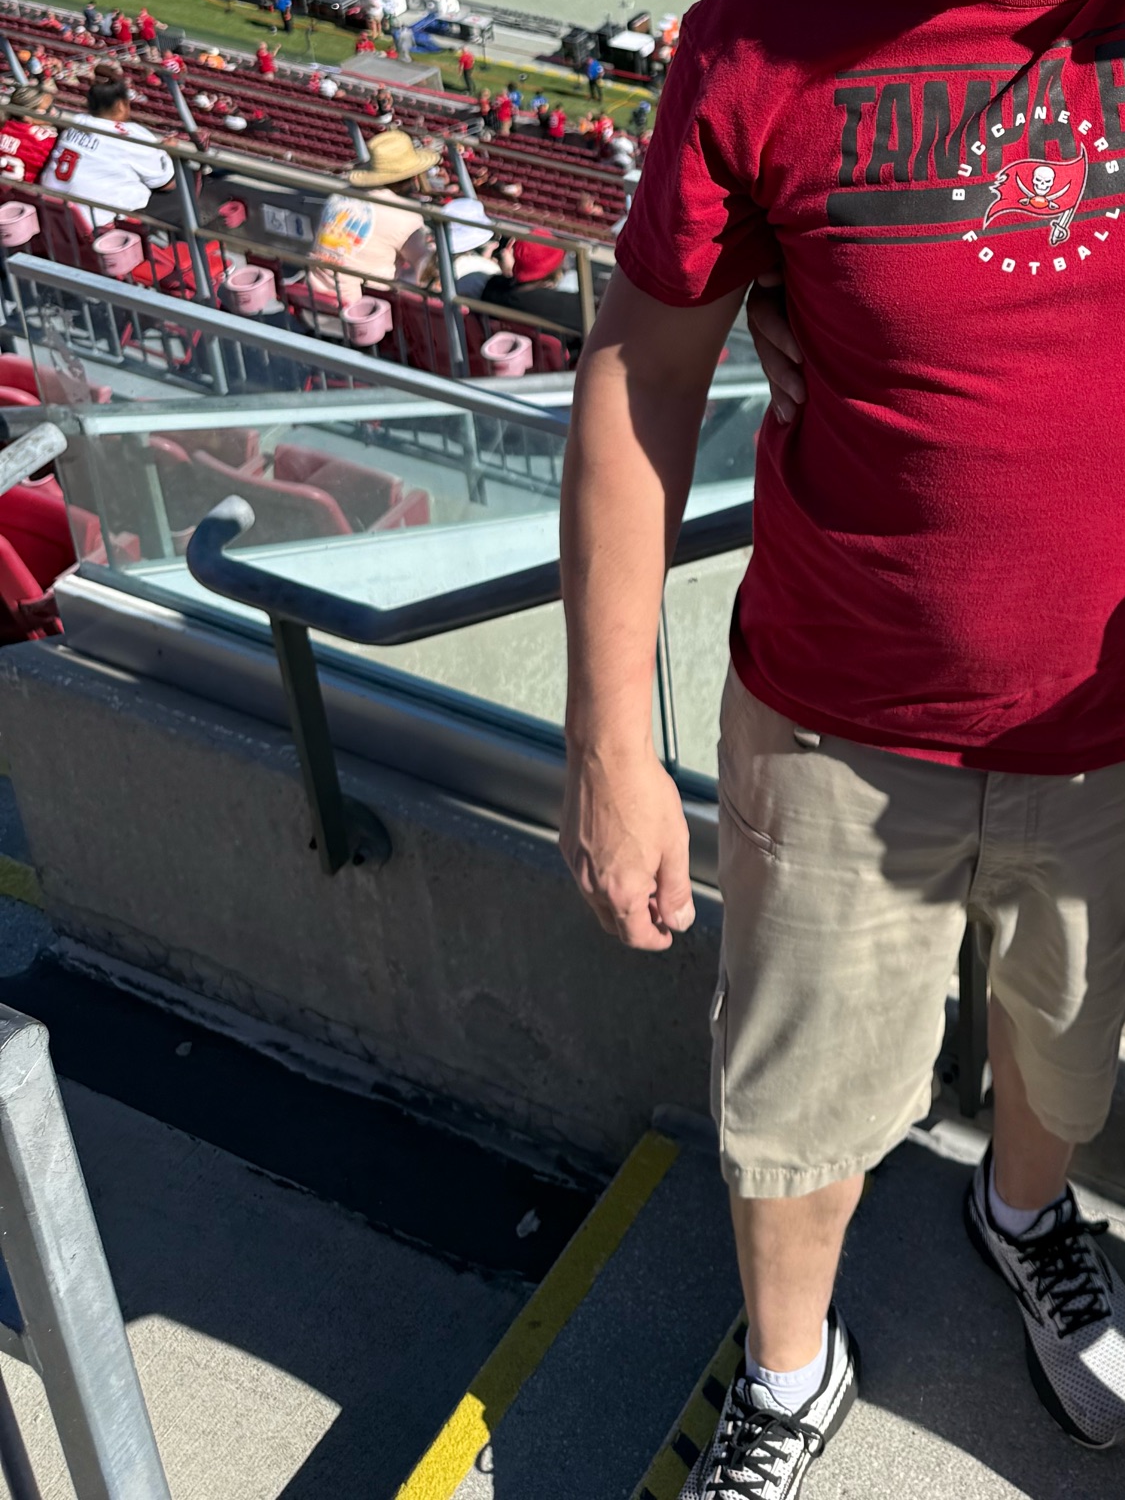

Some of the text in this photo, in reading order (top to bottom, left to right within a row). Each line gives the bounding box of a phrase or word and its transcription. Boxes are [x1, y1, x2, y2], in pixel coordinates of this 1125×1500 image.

[834, 57, 1078, 188] TAMPA
[952, 106, 1120, 202] BUCCANEERS
[962, 208, 1120, 274] FOOTBALL
